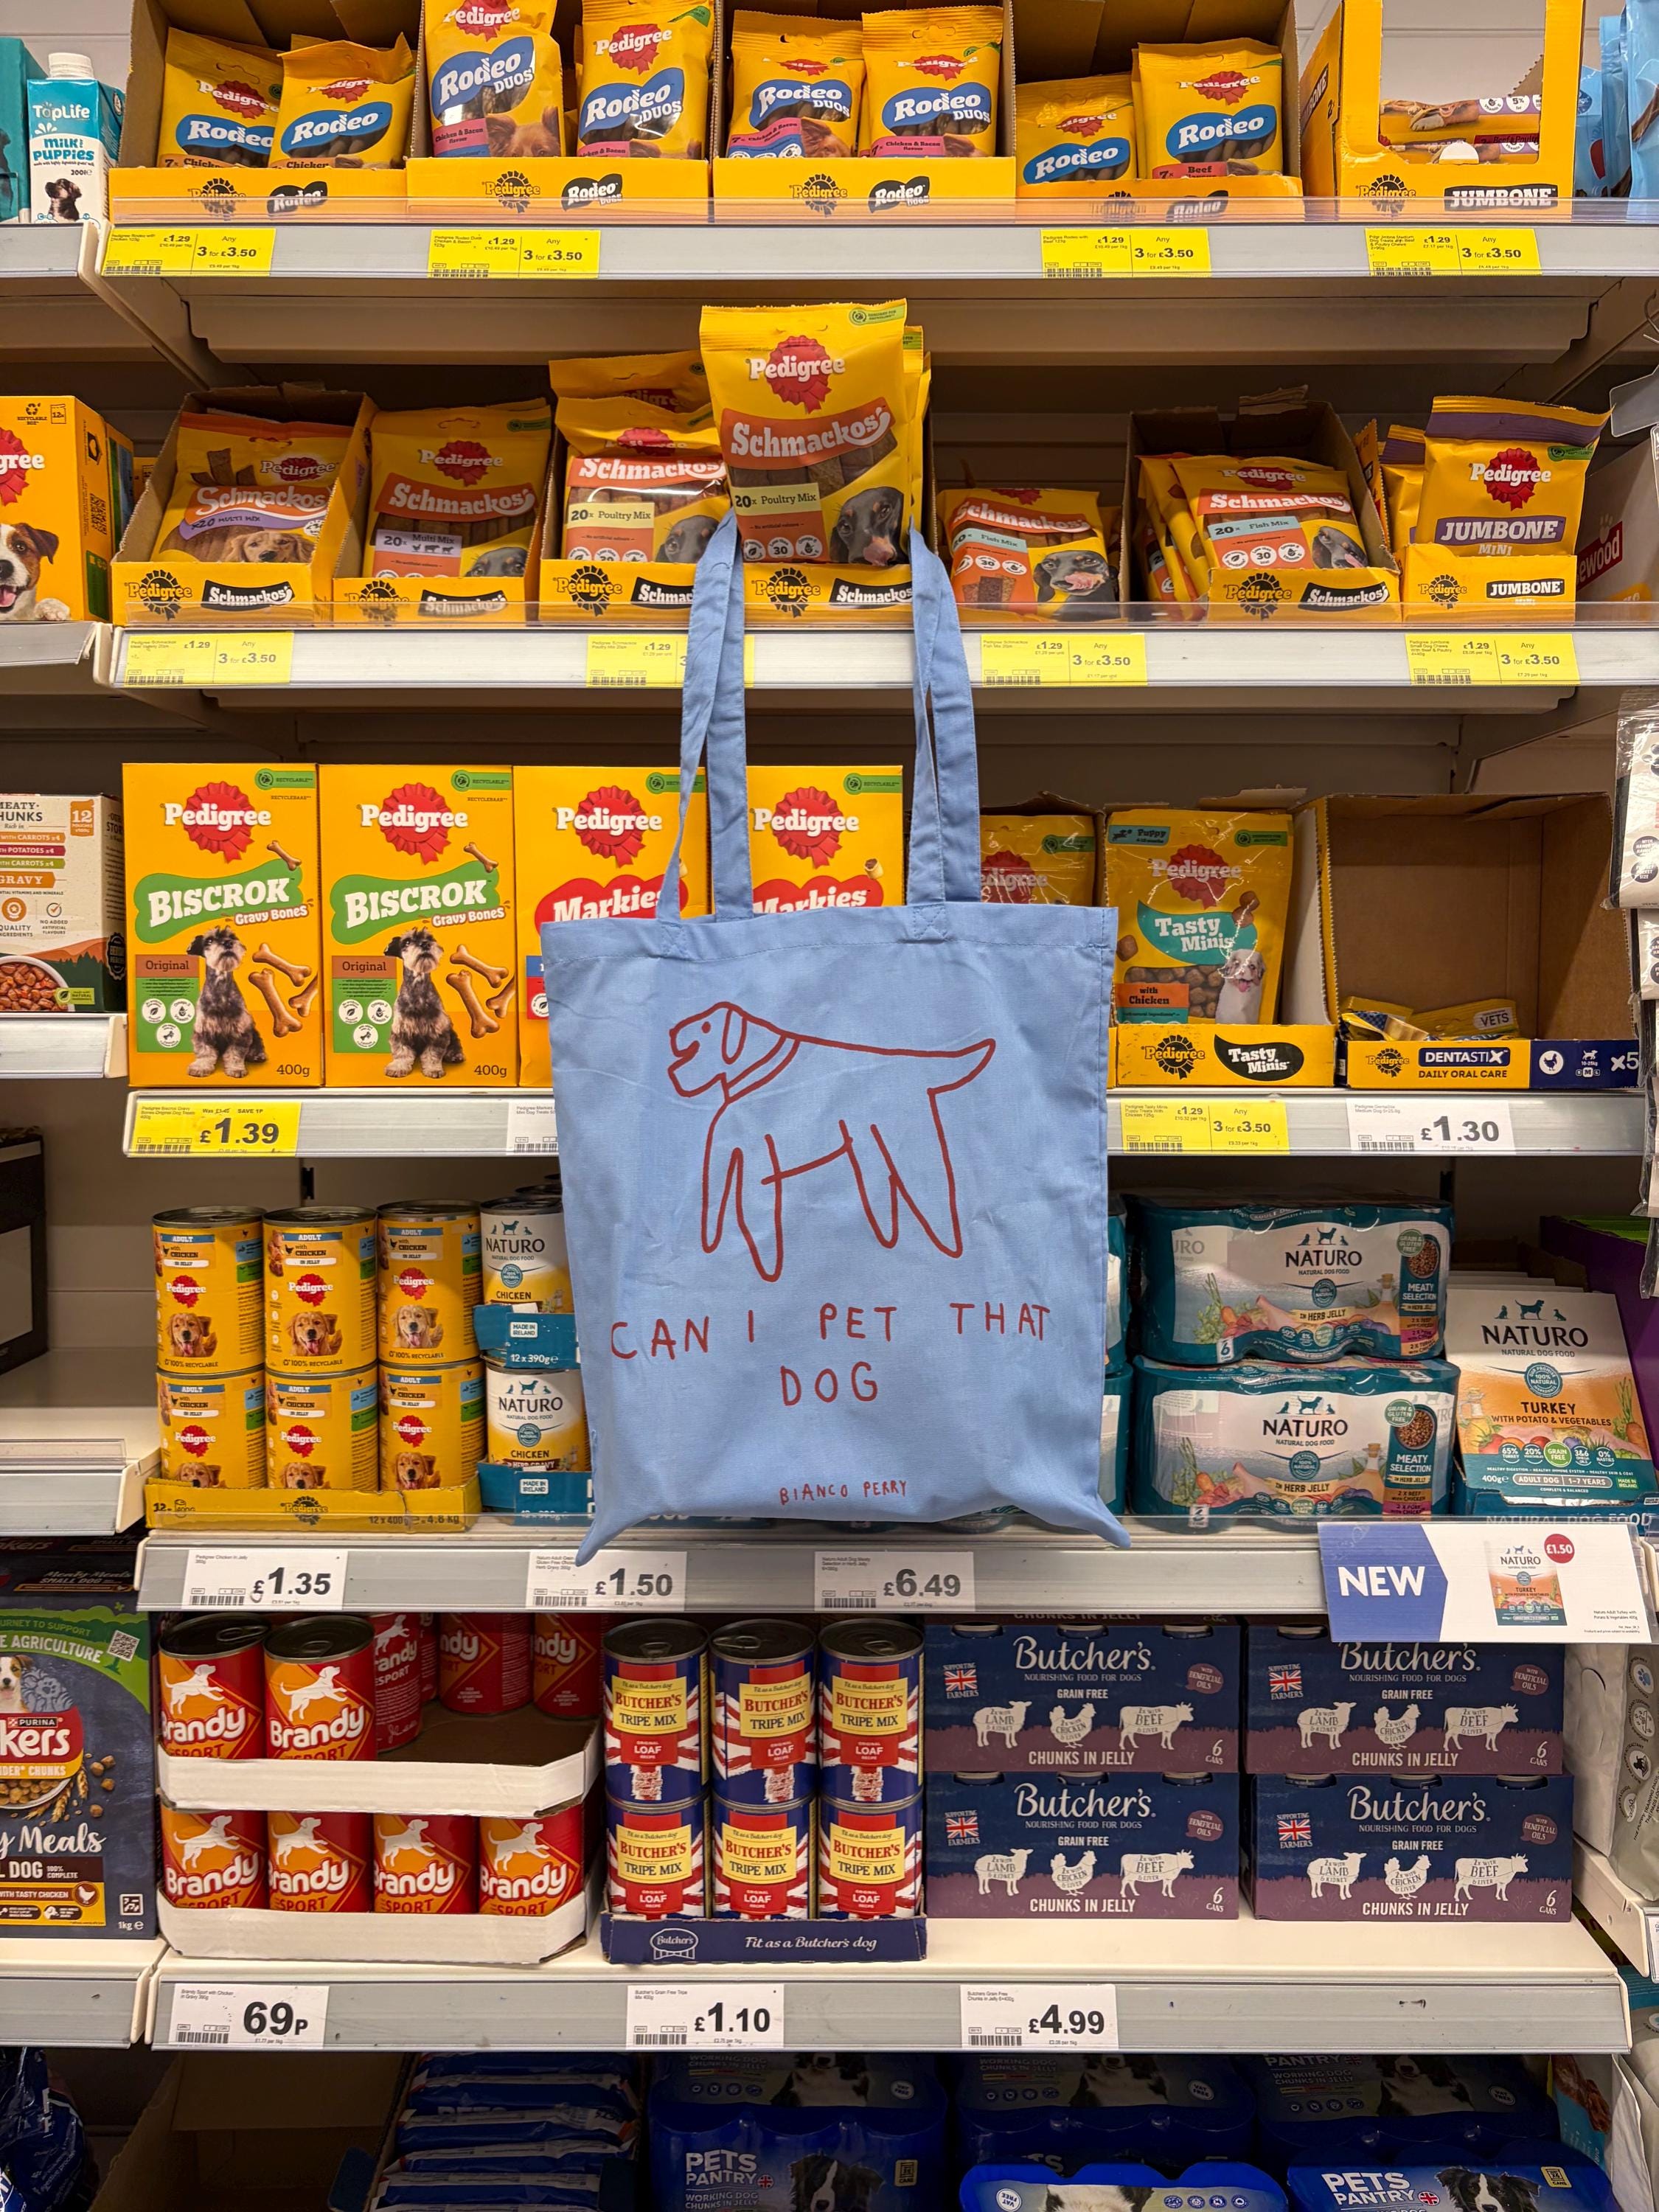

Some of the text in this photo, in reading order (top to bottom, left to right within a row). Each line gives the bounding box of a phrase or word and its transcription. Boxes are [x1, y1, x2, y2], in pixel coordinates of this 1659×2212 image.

[595, 28, 672, 55] Pedigree
[439, 52, 521, 105] Rodeo
[494, 67, 534, 94] DUOS
[32, 104, 90, 121] TopLife
[585, 84, 671, 128] Rodeo
[641, 100, 683, 124] DUOS
[894, 93, 981, 121] Rodeo
[953, 109, 990, 123] DUOS
[291, 112, 380, 145] Rodeo
[435, 127, 484, 142] Chicken Bacon
[1179, 114, 1264, 149] Rodeo
[1188, 166, 1212, 174] Beef
[485, 181, 540, 198] Pedigree
[1450, 188, 1553, 207] JUMBONE
[488, 237, 515, 245] £1.29
[524, 250, 532, 260] 3
[547, 250, 582, 260] £3.50
[1462, 248, 1472, 257] 3
[1486, 248, 1521, 258] £3.50
[749, 358, 845, 381] Pedigree
[731, 414, 891, 458] Schmackos
[261, 459, 335, 478] Pedigree
[1470, 464, 1551, 486] Pedigree
[196, 487, 327, 516] Schmackos
[389, 483, 535, 516] Schmackos
[762, 493, 816, 506] Poultry Mix
[1211, 493, 1350, 513] Schmackos
[1250, 519, 1290, 530] Fish Mix
[1441, 521, 1558, 542] JUMBONE
[412, 534, 454, 545] Multi Mix
[1307, 585, 1389, 605] Schmackos
[184, 640, 255, 650] £1.29 Any
[219, 653, 276, 664] 3 for £3.50
[72, 810, 92, 823] 12
[164, 803, 271, 830] Pedigree
[362, 804, 468, 832] Pedigree
[754, 810, 860, 837] Pedigree
[1138, 829, 1166, 840] Puppy
[1152, 860, 1241, 880] Pedigree
[149, 878, 289, 927] BISCROK
[234, 905, 307, 926] Gravy Bones
[1155, 917, 1220, 936] Tasty
[1182, 933, 1233, 953] Minis
[146, 961, 189, 971] Original
[1129, 996, 1169, 1006] Chicken
[1480, 1013, 1509, 1026] VETS
[1229, 1048, 1276, 1062] Tasty
[276, 1065, 310, 1077] 400g
[1248, 1060, 1287, 1074] Minis
[1419, 1070, 1507, 1079] DAILY ORAL CARE
[1178, 1107, 1203, 1115] £1.29
[200, 1118, 279, 1144] £1.39
[1214, 1121, 1222, 1132] 3
[1237, 1121, 1270, 1133] £3.50
[1421, 1116, 1499, 1142] £1.30
[486, 1239, 545, 1253] NATURO
[1285, 1250, 1363, 1267] NATURO
[289, 1282, 333, 1295] Pedigree
[495, 1290, 532, 1299] CHICKEN
[611, 1302, 1050, 1360] CAN I PET THAT
[1482, 1326, 1588, 1347] NATURO
[781, 1361, 878, 1406] DOG
[1521, 1402, 1576, 1414] TURKEY
[1262, 1419, 1348, 1437] NATURO
[1397, 1455, 1427, 1464] MEATY
[1390, 1464, 1431, 1473] SELECTION
[780, 1480, 908, 1506] BIANCO PERRY
[1546, 1545, 1573, 1554] £1.50
[1500, 1557, 1540, 1565] NATURO
[253, 1568, 330, 1596] £1.35
[595, 1568, 673, 1596] £1.50
[883, 1568, 961, 1598] £6.49
[1339, 1566, 1425, 1596] NEW
[47, 1624, 91, 1636] SUPPORT
[12, 1635, 103, 1663] AGRICULTURE
[1014, 1636, 1152, 1671] Butcher's
[616, 1694, 681, 1710] BUTCHER'S
[1057, 1689, 1108, 1698] GRAIN FREE
[271, 1705, 364, 1750] Brandy
[620, 1714, 676, 1726] TRIPE MIX
[986, 1714, 1015, 1725] LAMB
[1135, 1714, 1163, 1725] BEEF
[633, 1745, 661, 1755] LOAF
[1029, 1751, 1134, 1765] CHUNKS IN JELLY
[28, 1766, 66, 1775] CHUNKS
[1347, 1786, 1486, 1820] Butcher's
[18, 1823, 105, 1854] Meals
[9, 1861, 43, 1878] DOG
[481, 1864, 568, 1898] Brandy
[386, 1899, 434, 1913] SPORT
[1363, 1902, 1469, 1916] CHUNKS IN JELLY
[745, 1936, 763, 1948] Fit
[765, 1939, 780, 1948] as
[783, 1939, 792, 1948] a
[853, 1936, 877, 1952] dog
[695, 2003, 770, 2032] £1.10
[1029, 2005, 1105, 2034] £4.99
[686, 2150, 757, 2172] PETS
[686, 2171, 757, 2185] PANTRY
